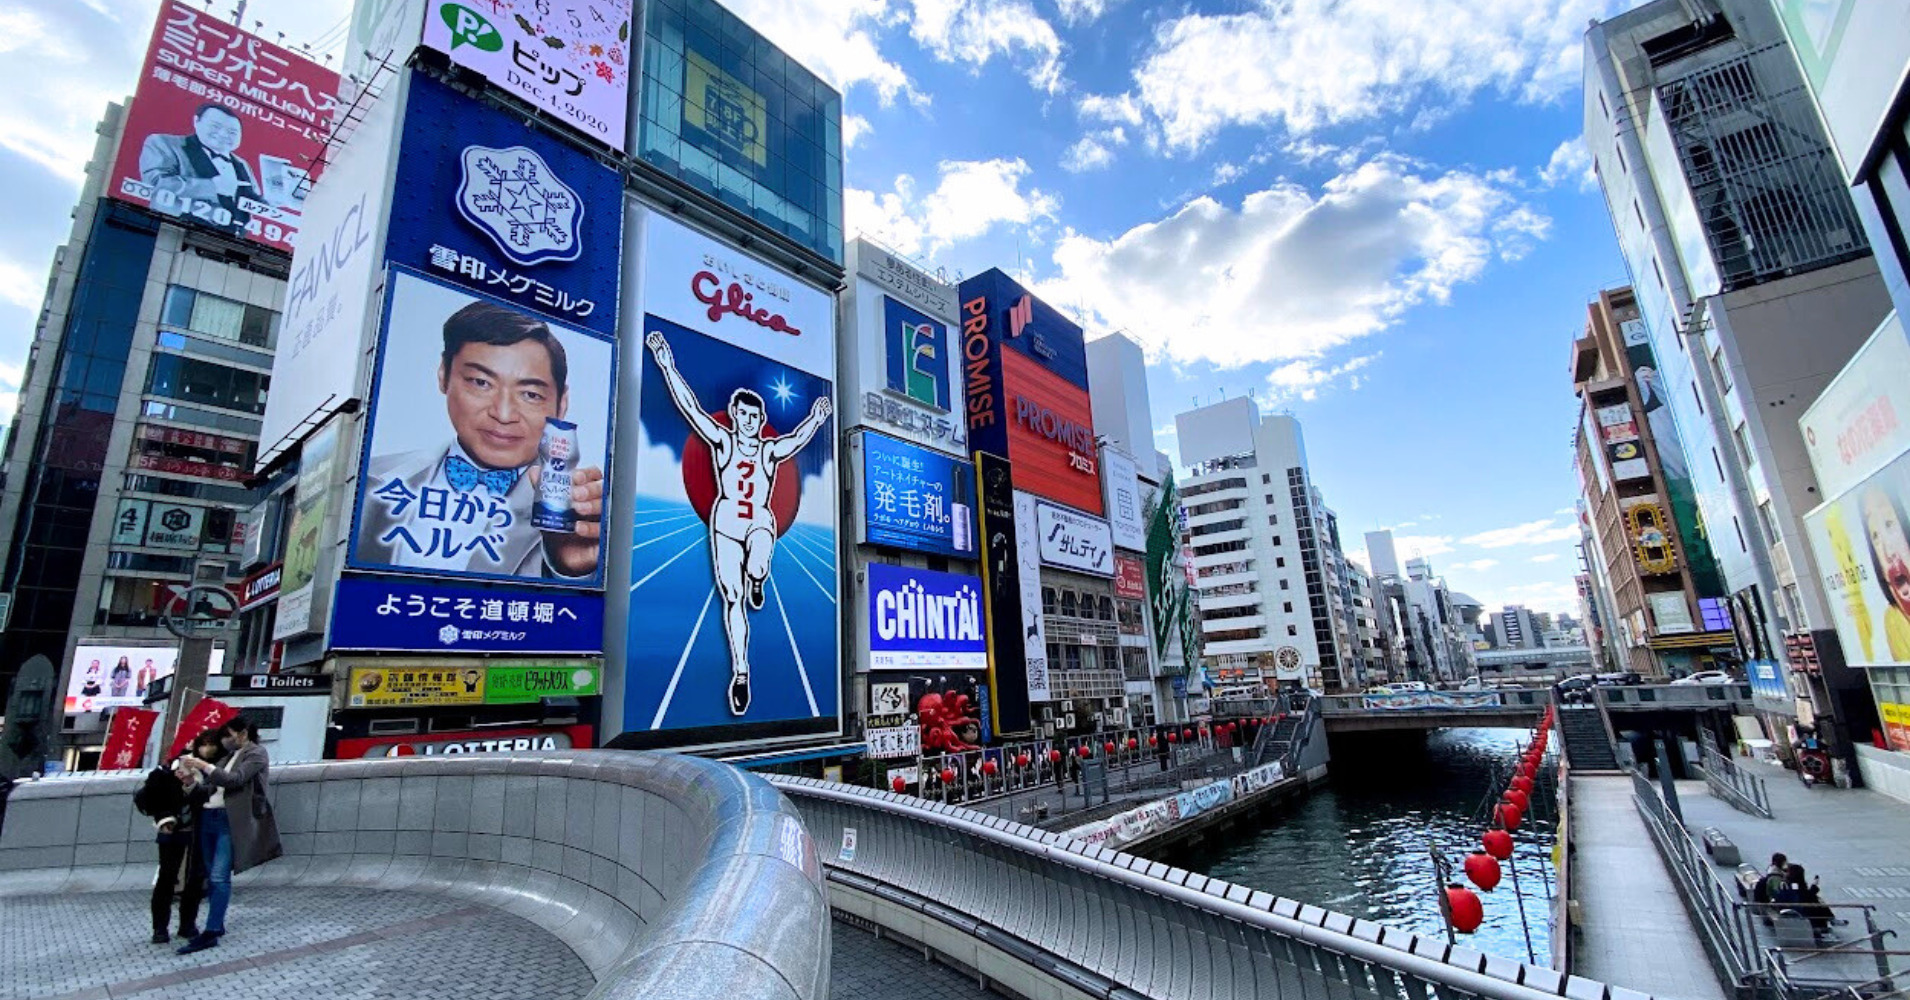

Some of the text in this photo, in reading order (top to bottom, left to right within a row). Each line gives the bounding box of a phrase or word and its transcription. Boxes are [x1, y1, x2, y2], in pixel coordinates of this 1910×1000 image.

[167, 4, 290, 67] スーパー
[566, 9, 582, 29] 5
[588, 4, 605, 23] 4
[157, 48, 316, 123] SUPER MILLION
[512, 40, 587, 96] ピップ
[506, 69, 546, 102] Dec.
[564, 102, 608, 135] 2020
[286, 192, 370, 330] FANCL
[428, 243, 596, 318] 雪印メグミルク
[691, 270, 801, 337] Glico
[962, 295, 995, 430] PROMISE
[1015, 393, 1096, 458] PROMISE
[736, 459, 757, 520] グリコ
[872, 465, 943, 492] アートネイチャーの
[1068, 450, 1096, 476] プロミス
[373, 477, 513, 528] 今日から
[873, 480, 951, 524] 発毛剤。
[381, 526, 506, 563] ヘルベ
[376, 593, 578, 624] ようこそ道頓堀へ
[461, 630, 527, 641] 雪印メグミルク
[270, 677, 314, 687] Toilets
